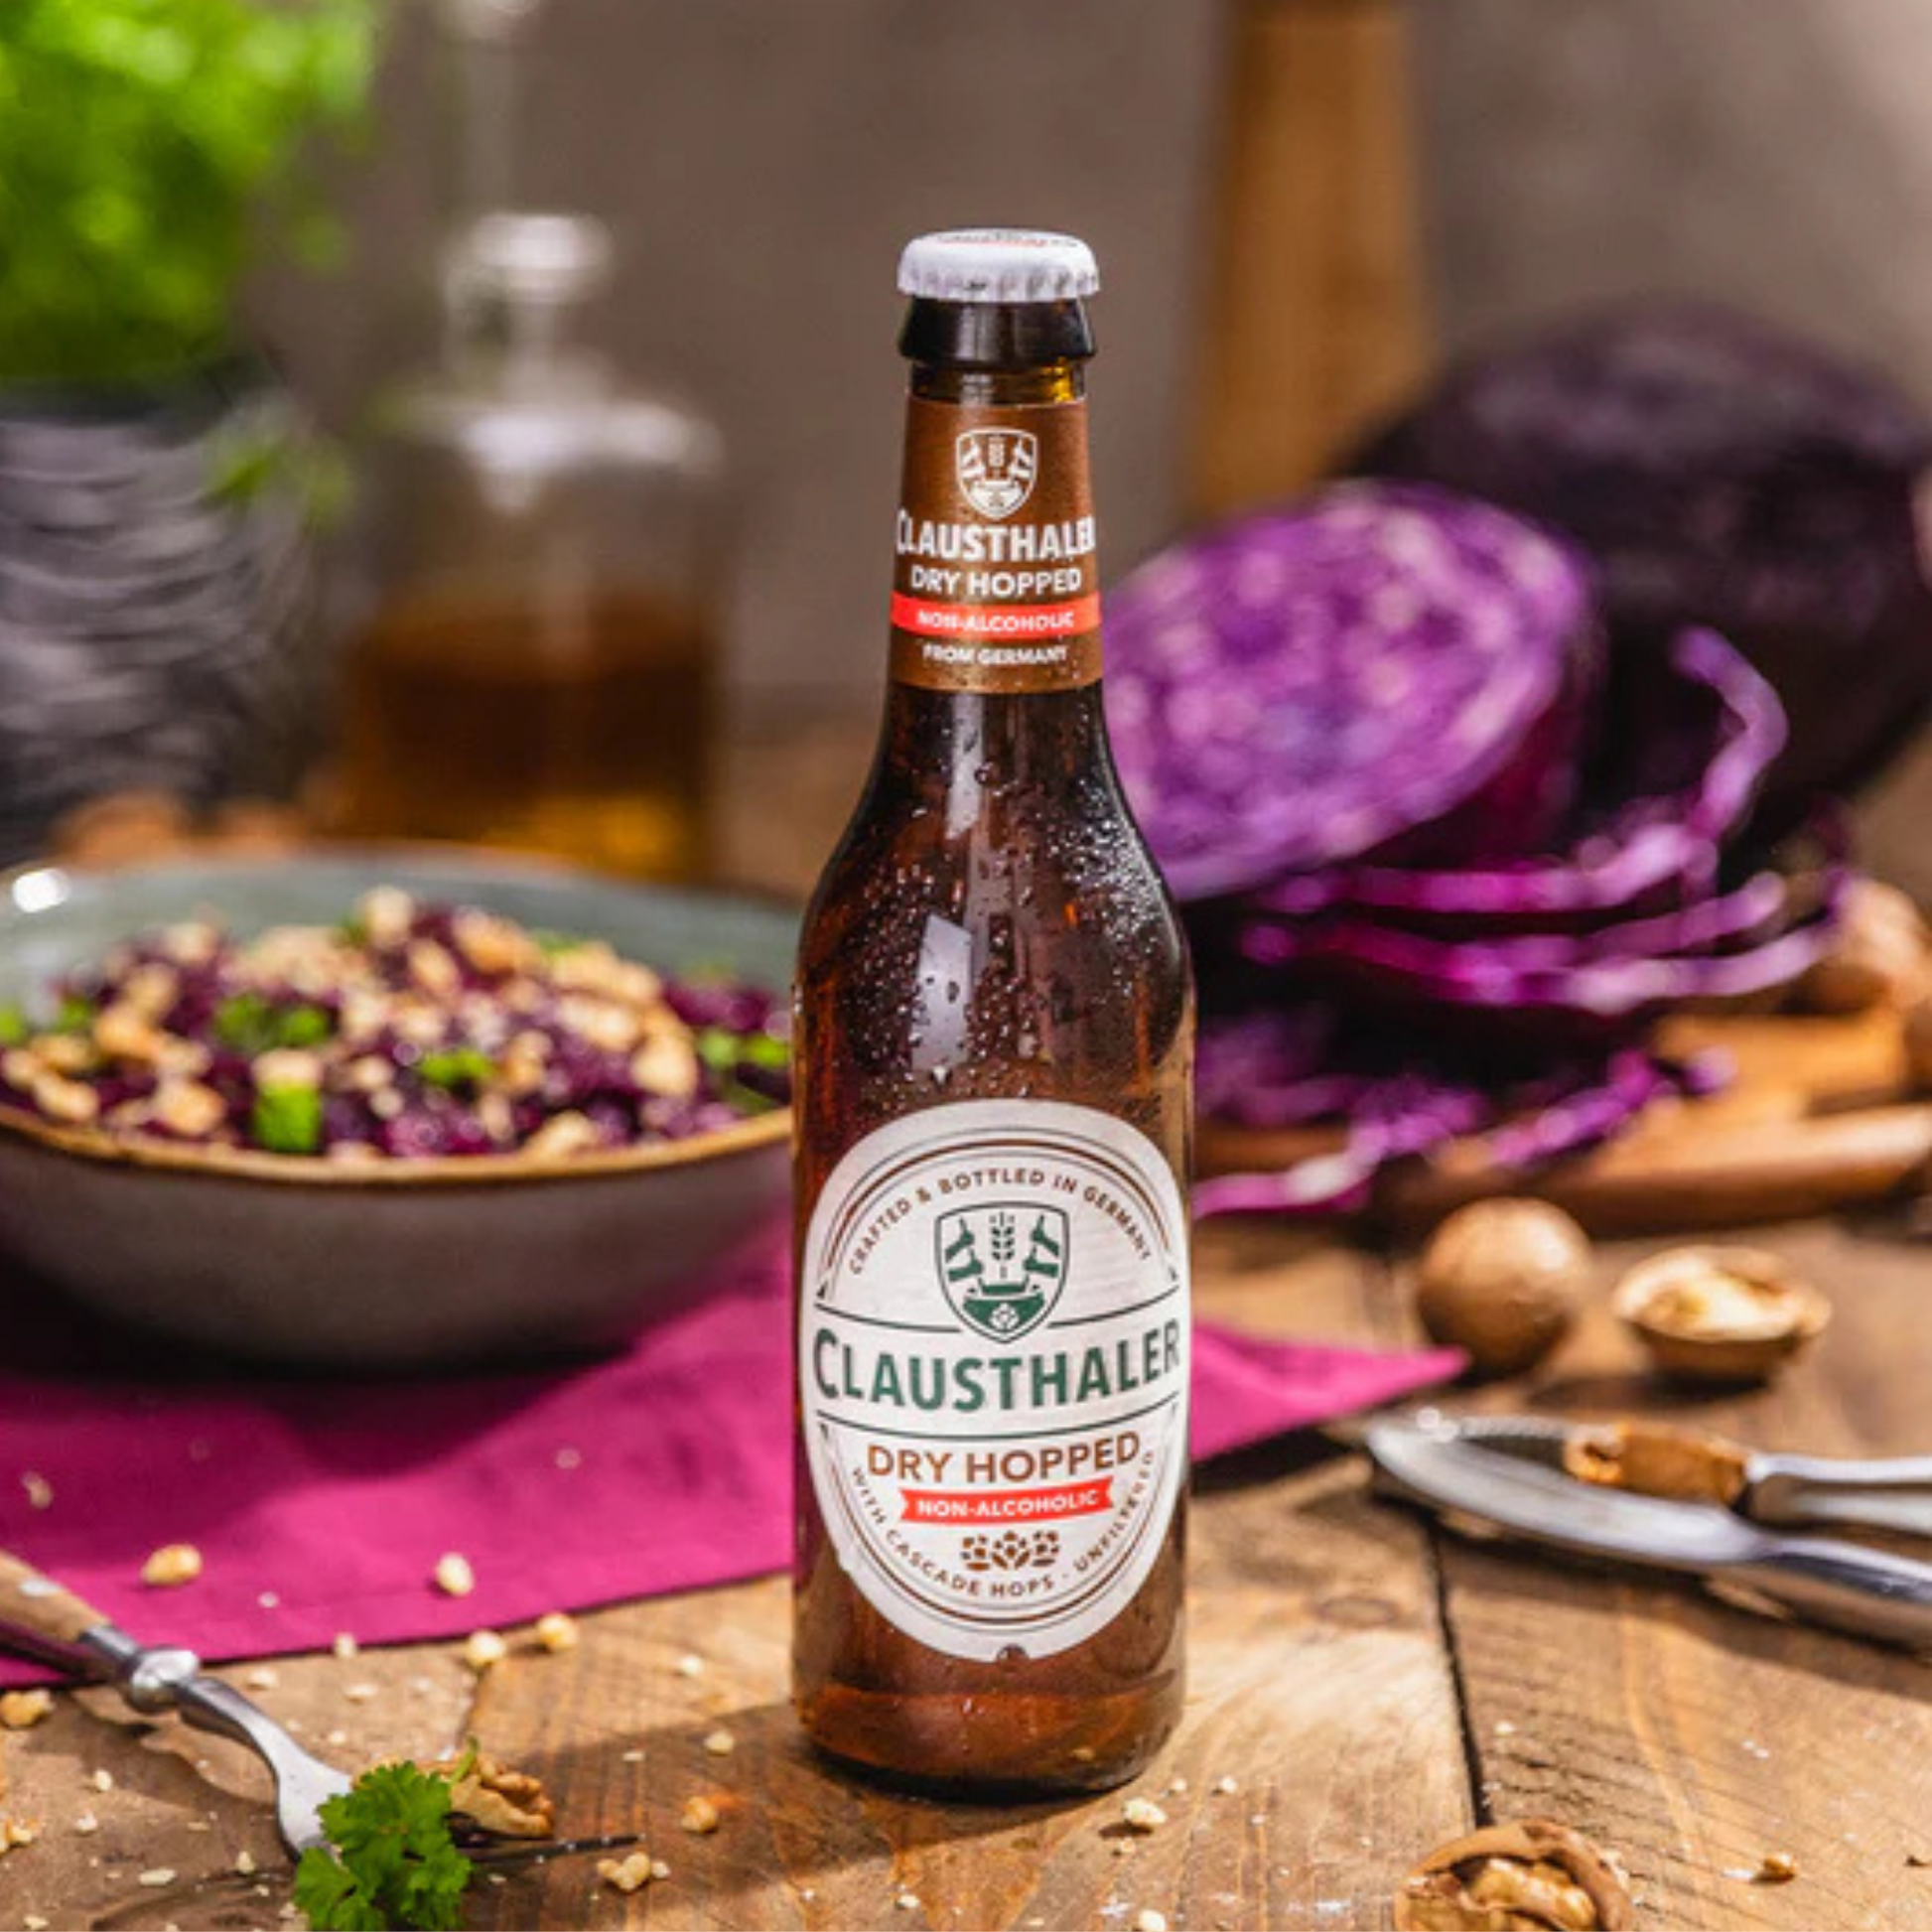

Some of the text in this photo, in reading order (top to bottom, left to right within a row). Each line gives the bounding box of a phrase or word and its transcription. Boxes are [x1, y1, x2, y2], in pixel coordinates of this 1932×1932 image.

[911, 564, 1081, 597] DRY HOPPED
[917, 609, 1074, 632] NON-ALCOHOLIC
[922, 643, 1067, 665] FROM GERMANY
[849, 1168, 1152, 1275] CRAFTED & BOTTLED IN GERMANY
[813, 1317, 1181, 1412] CLAUSTHALER
[868, 1430, 1141, 1483] DRY HOPPED
[851, 1450, 1154, 1597] WITH CASCADE HOPS UNFILTERED
[915, 1489, 1098, 1518] NON-ALCOHOLIC
